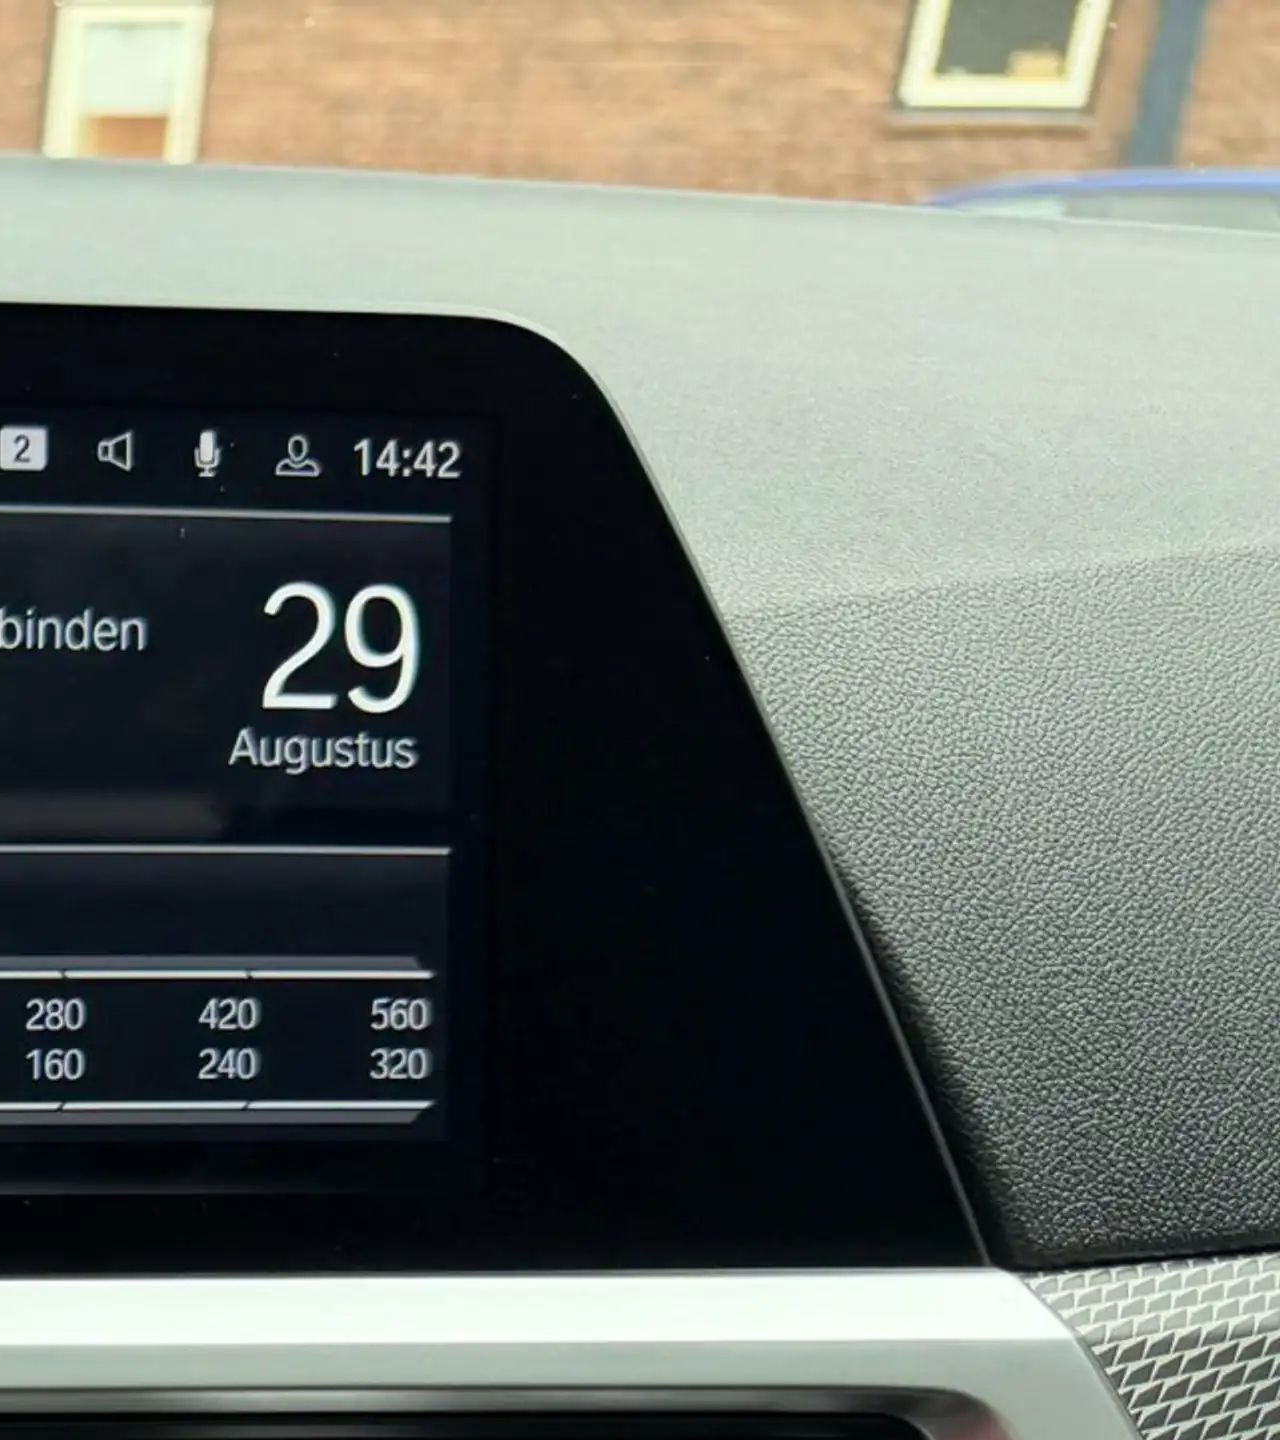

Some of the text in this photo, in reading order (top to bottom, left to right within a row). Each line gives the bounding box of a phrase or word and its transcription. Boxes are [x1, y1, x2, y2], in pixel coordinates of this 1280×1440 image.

[14, 434, 30, 463] 2
[353, 438, 460, 478] 14:42
[262, 581, 420, 714] 29
[228, 727, 417, 775] Augustus
[25, 998, 85, 1031] 280
[198, 998, 258, 1030] 420
[371, 997, 429, 1030] 560
[26, 1048, 85, 1081] 160
[198, 1047, 257, 1080] 240
[370, 1048, 428, 1080] 320
